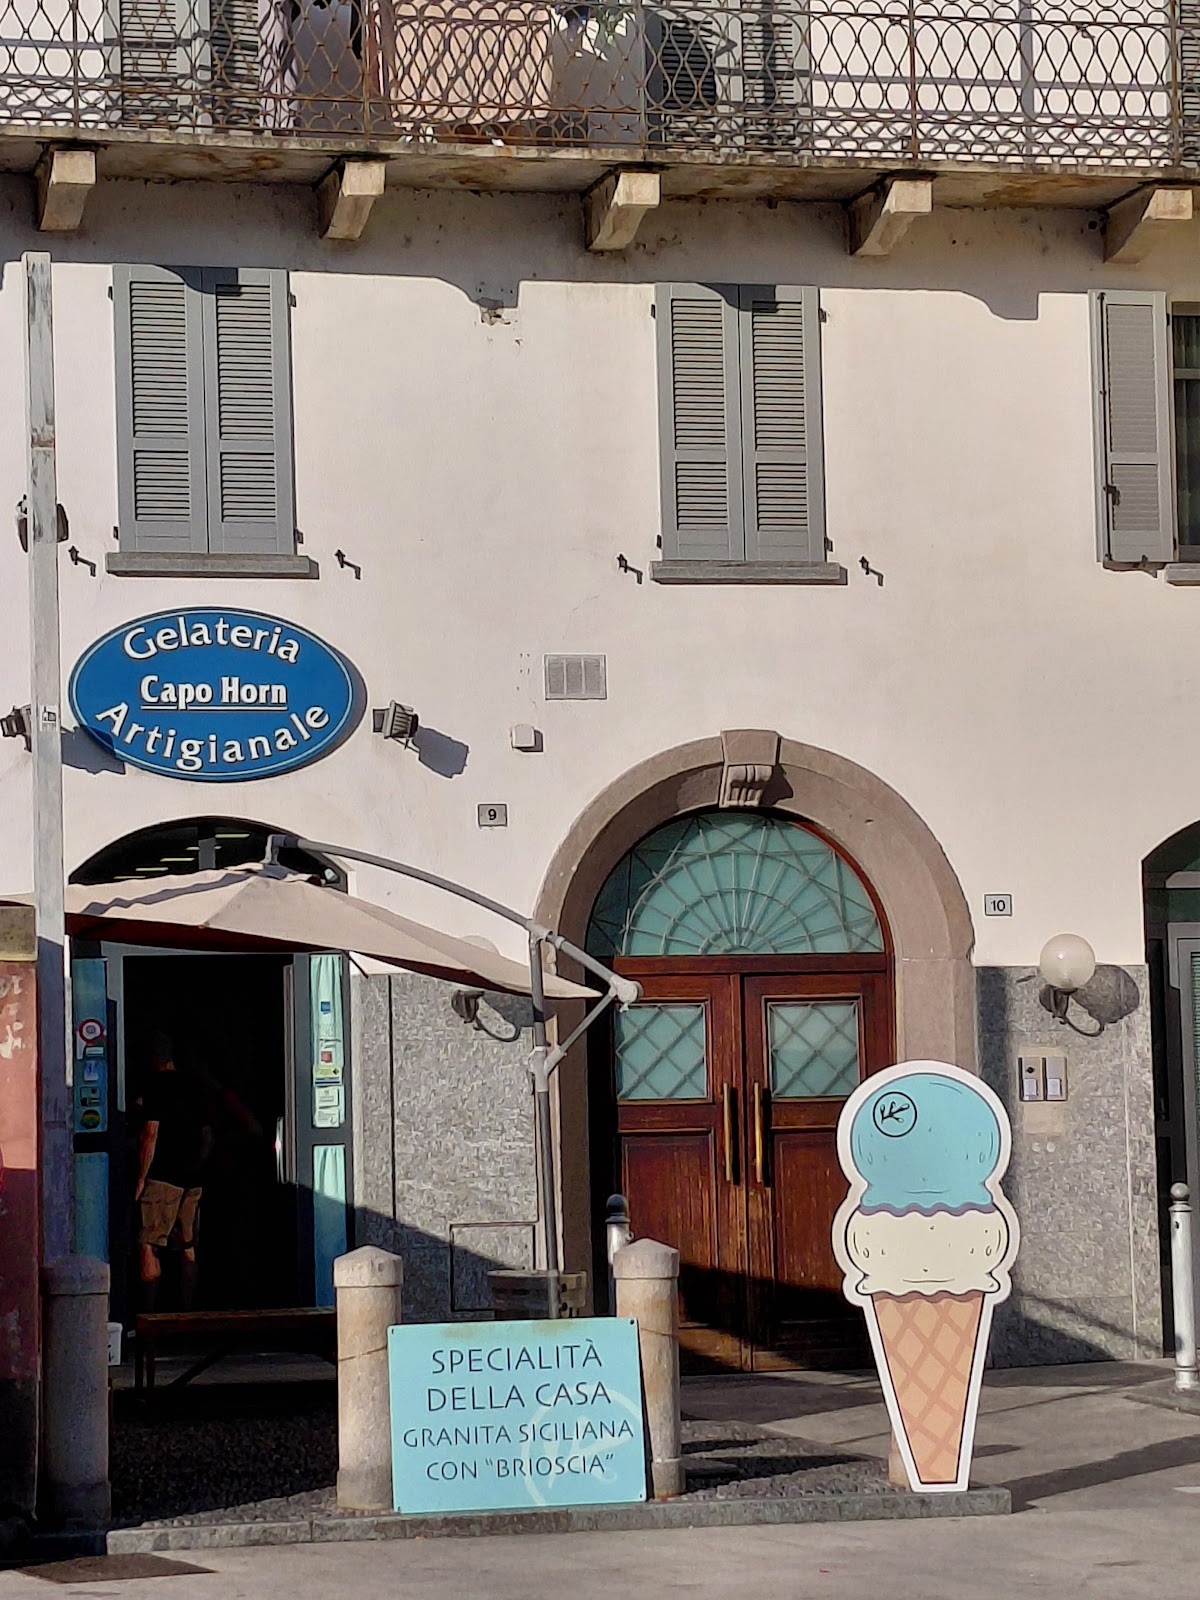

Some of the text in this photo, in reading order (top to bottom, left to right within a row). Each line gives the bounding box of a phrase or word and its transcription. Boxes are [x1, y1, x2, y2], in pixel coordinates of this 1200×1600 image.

[123, 616, 301, 663] Gelateria
[140, 675, 288, 710] Capo Horn
[95, 702, 331, 771] Artigianale
[488, 808, 497, 821] 9
[990, 899, 1006, 912] 10
[431, 1338, 603, 1374] SPECIALITÀ
[427, 1381, 612, 1411] DELLA CASA
[403, 1419, 634, 1448] GRANITA SICILIANA
[426, 1453, 614, 1481] CON "BRIOSCIA"
